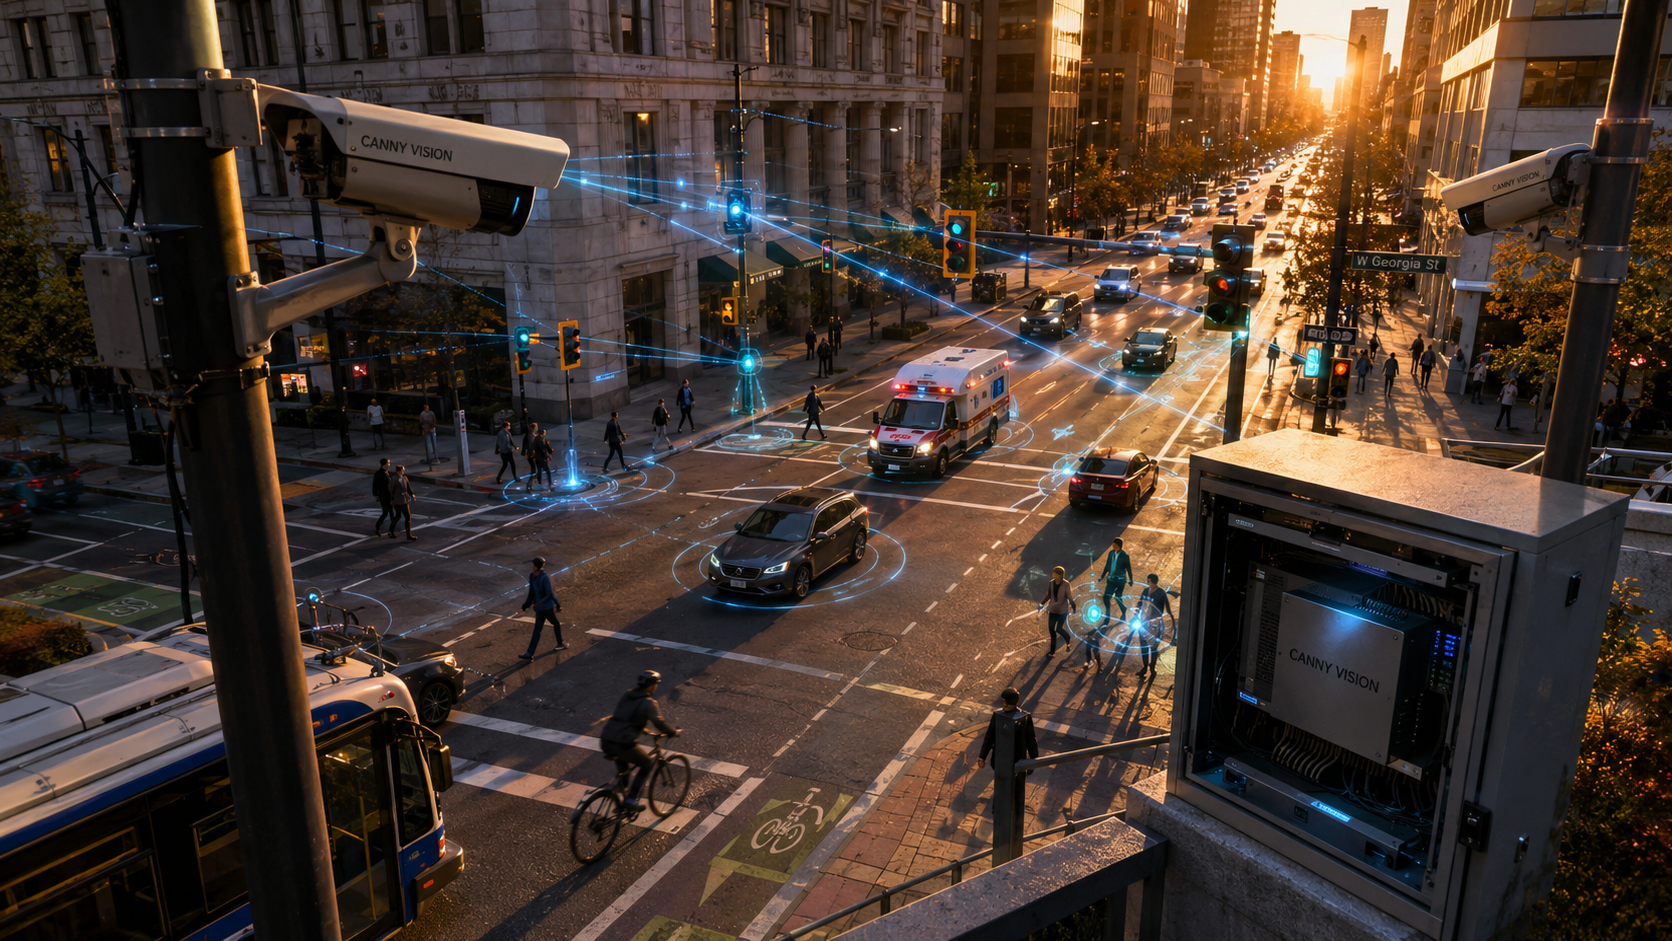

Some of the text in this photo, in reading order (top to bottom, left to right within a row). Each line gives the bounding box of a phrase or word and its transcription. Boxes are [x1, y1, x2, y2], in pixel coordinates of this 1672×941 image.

[361, 135, 453, 162] CANNY VISION
[1357, 255, 1440, 271] W Georgia St
[1289, 648, 1380, 694] CANNY VISION
